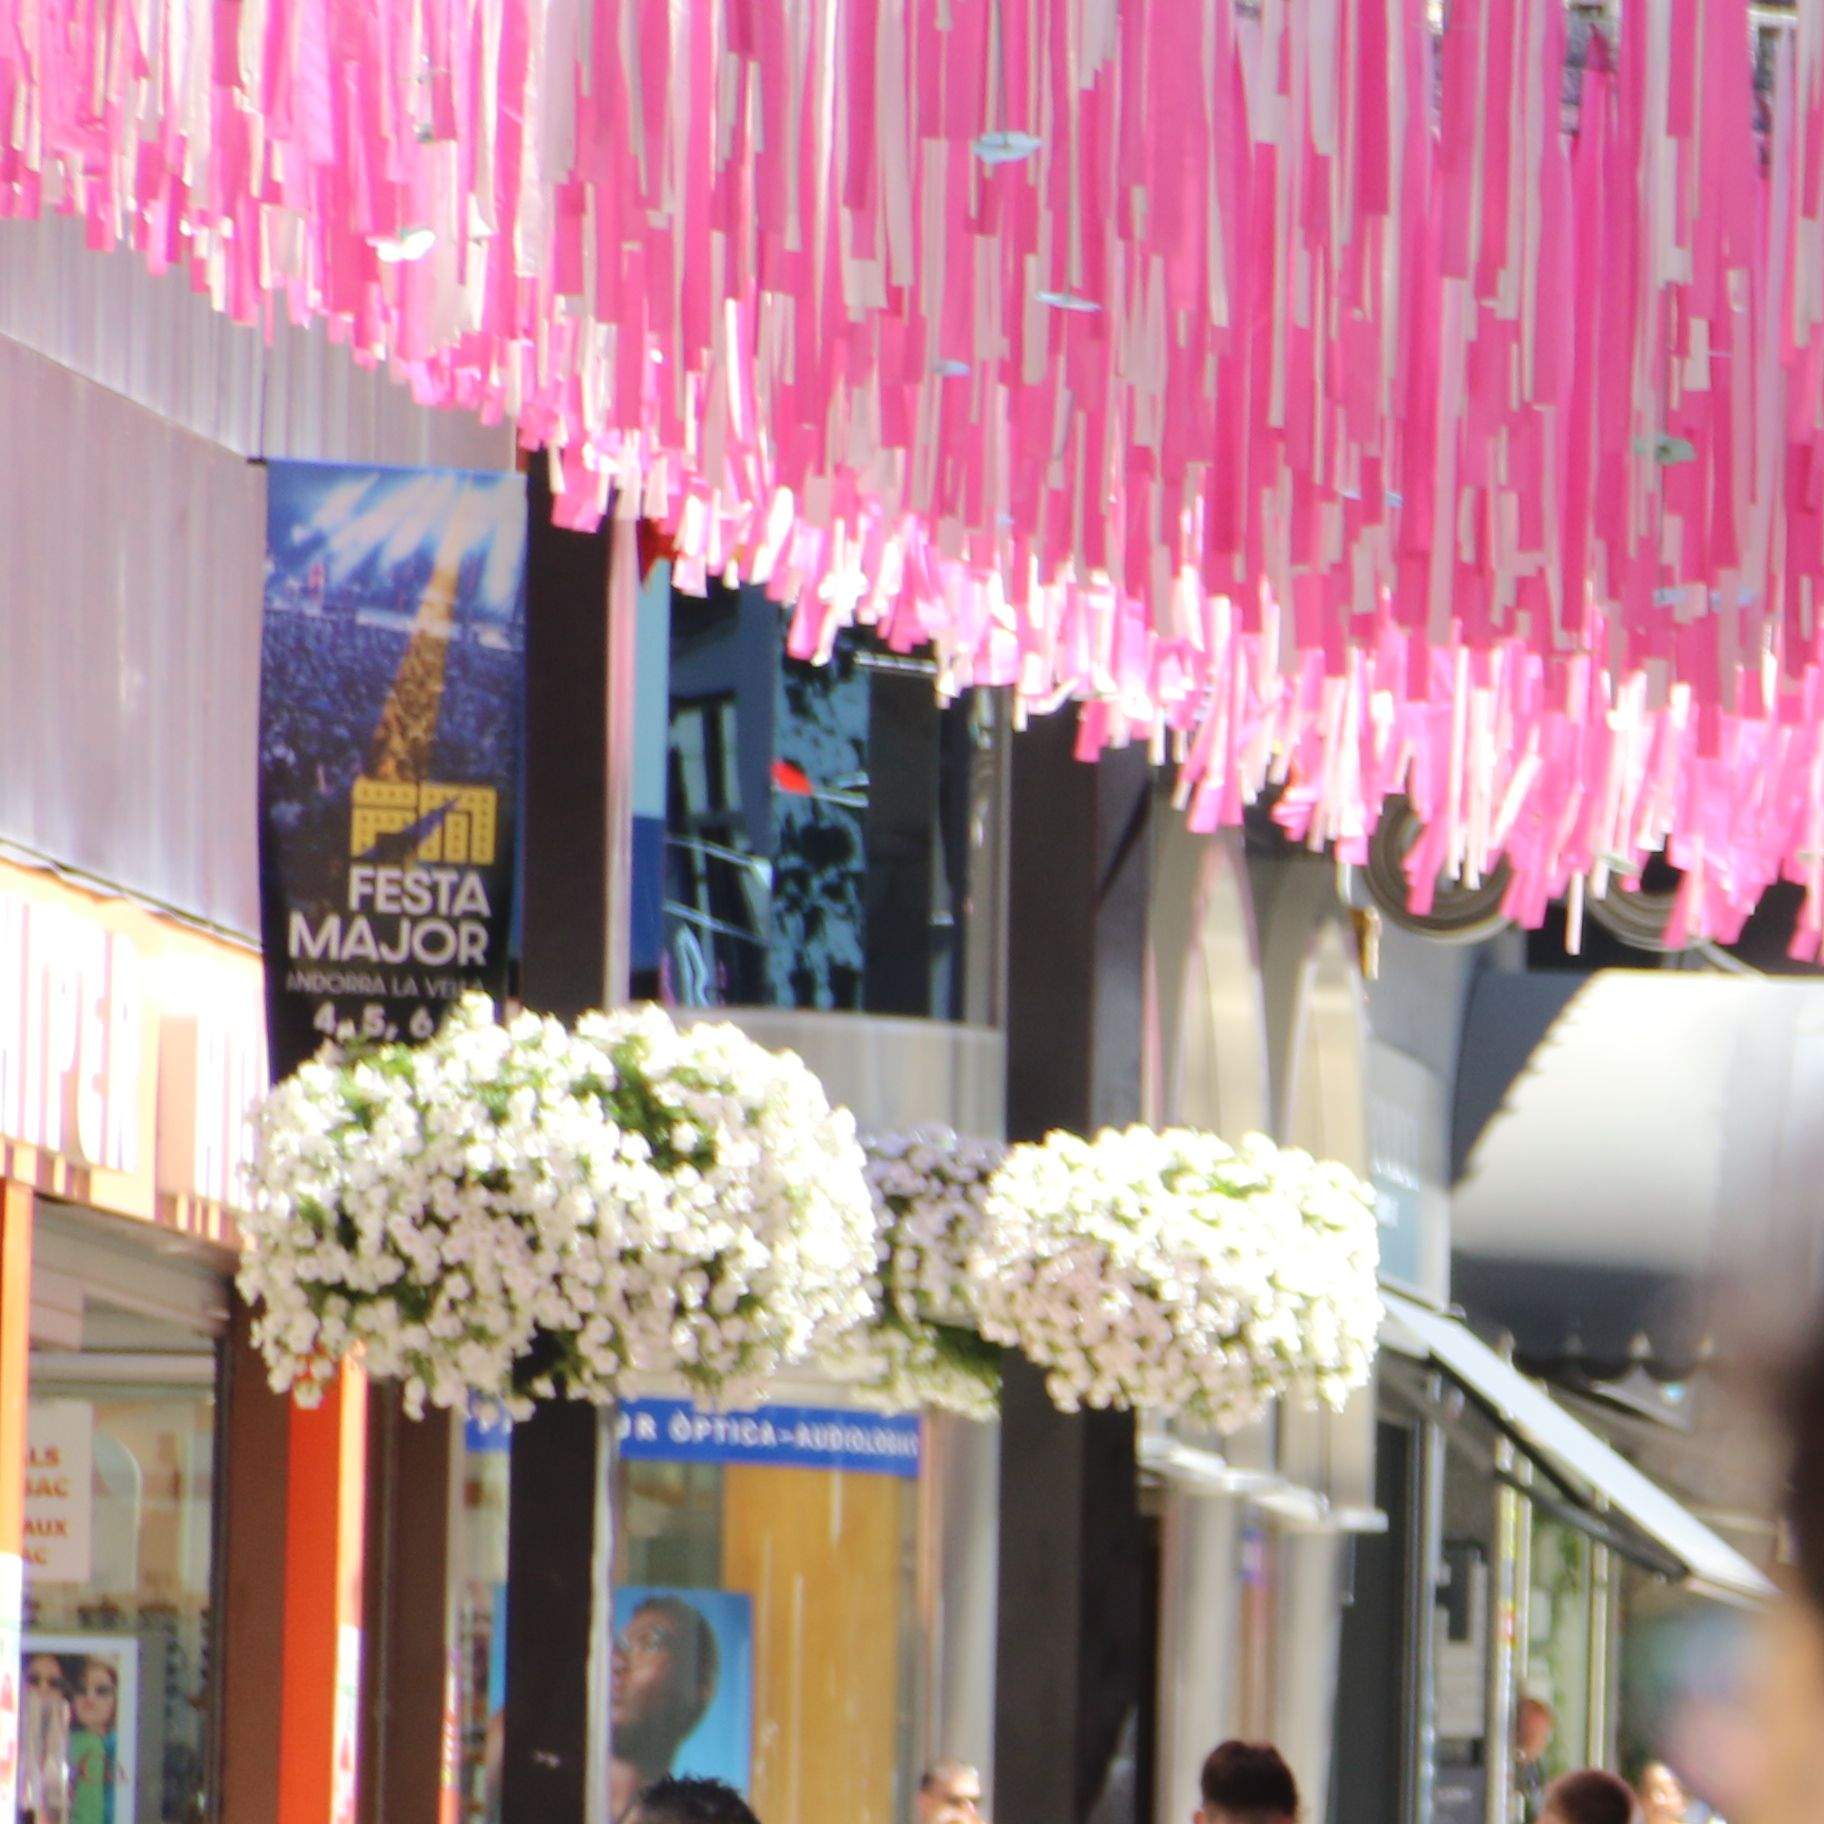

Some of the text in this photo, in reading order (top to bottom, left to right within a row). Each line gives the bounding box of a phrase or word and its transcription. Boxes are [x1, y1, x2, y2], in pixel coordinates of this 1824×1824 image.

[349, 866, 491, 918] FESTA
[289, 910, 489, 967] MAJOR
[286, 971, 387, 997] ANDORRA
[392, 976, 419, 997] LA
